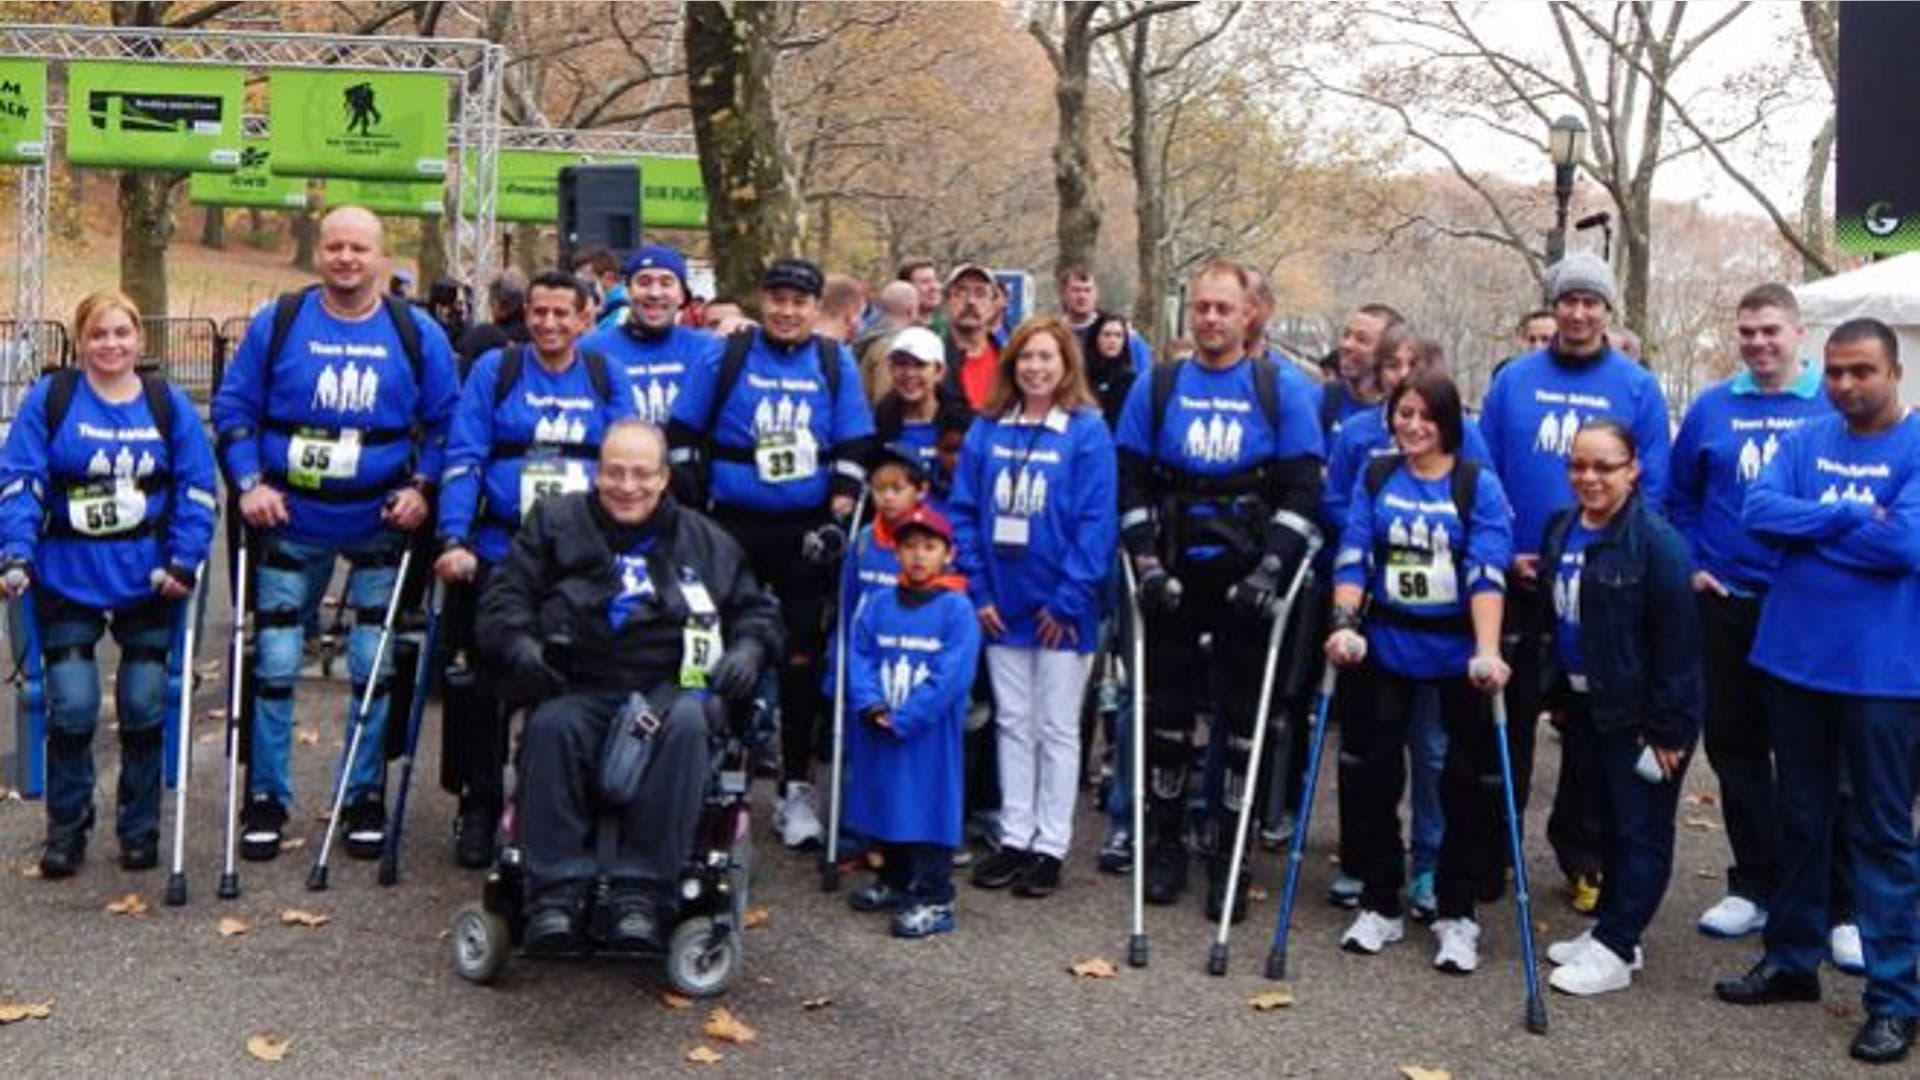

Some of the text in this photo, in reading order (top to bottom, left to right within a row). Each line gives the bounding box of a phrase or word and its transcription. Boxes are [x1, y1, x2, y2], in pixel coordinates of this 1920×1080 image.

[302, 443, 331, 472] 55
[769, 450, 796, 478] 33
[1399, 570, 1428, 599] 58
